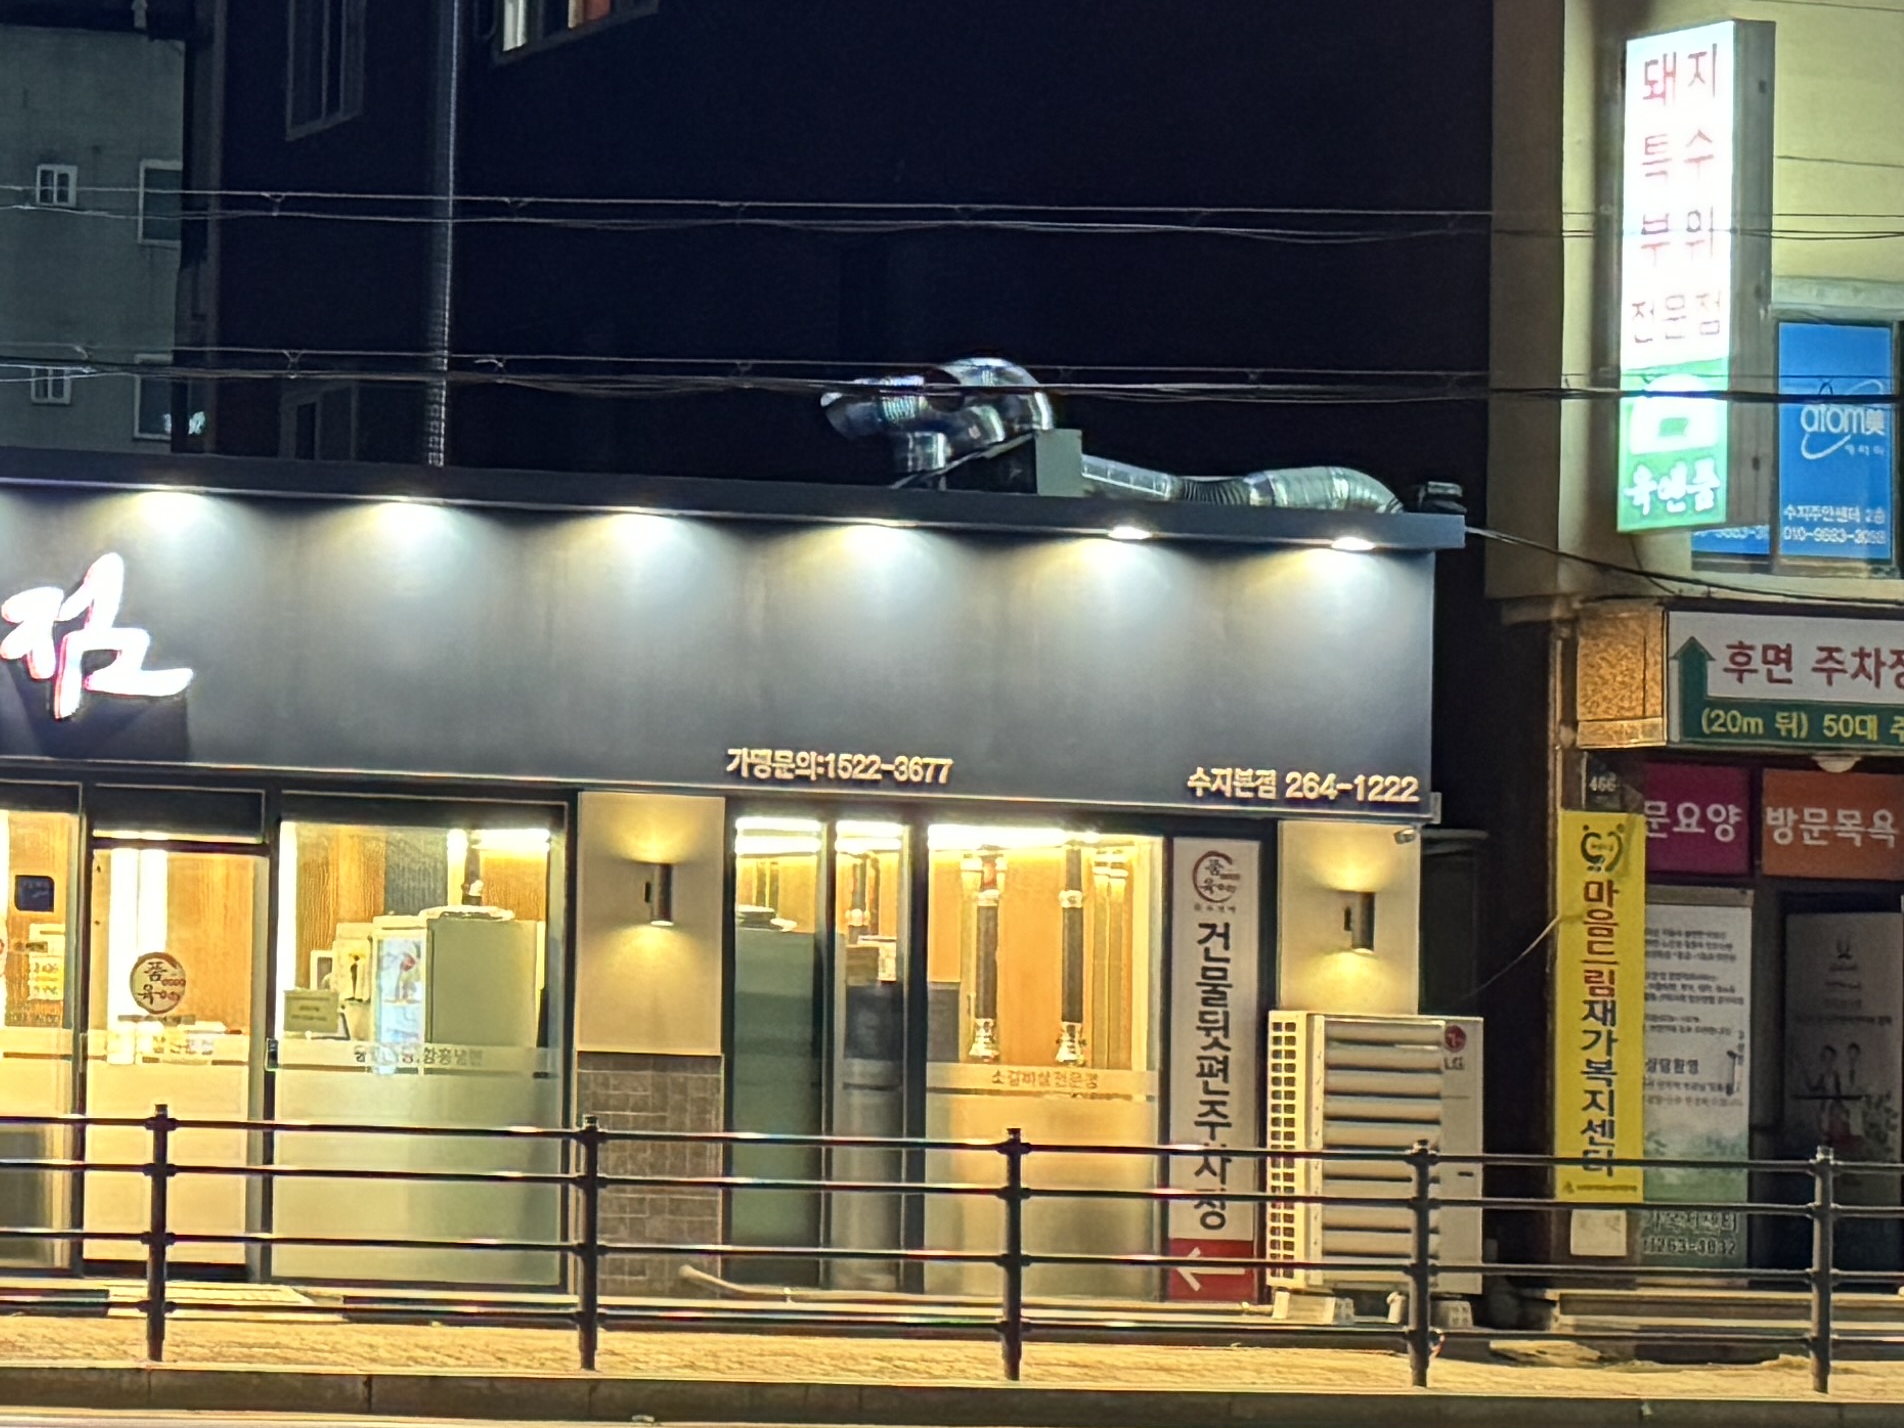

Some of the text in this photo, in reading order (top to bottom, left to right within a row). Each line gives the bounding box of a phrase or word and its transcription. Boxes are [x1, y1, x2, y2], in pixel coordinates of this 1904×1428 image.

[1642, 43, 1720, 105] 돼지
[1641, 129, 1717, 180] 특수
[1640, 207, 1716, 270] 부위
[1630, 290, 1722, 346] 전문점
[1723, 640, 1794, 684] 후면
[1701, 708, 1764, 737] (20m
[1774, 710, 1809, 739] 뒤)
[1822, 713, 1879, 741] 50대
[1187, 766, 1421, 803] 수지본점 264-1222
[1766, 806, 1899, 848] 방문목욕
